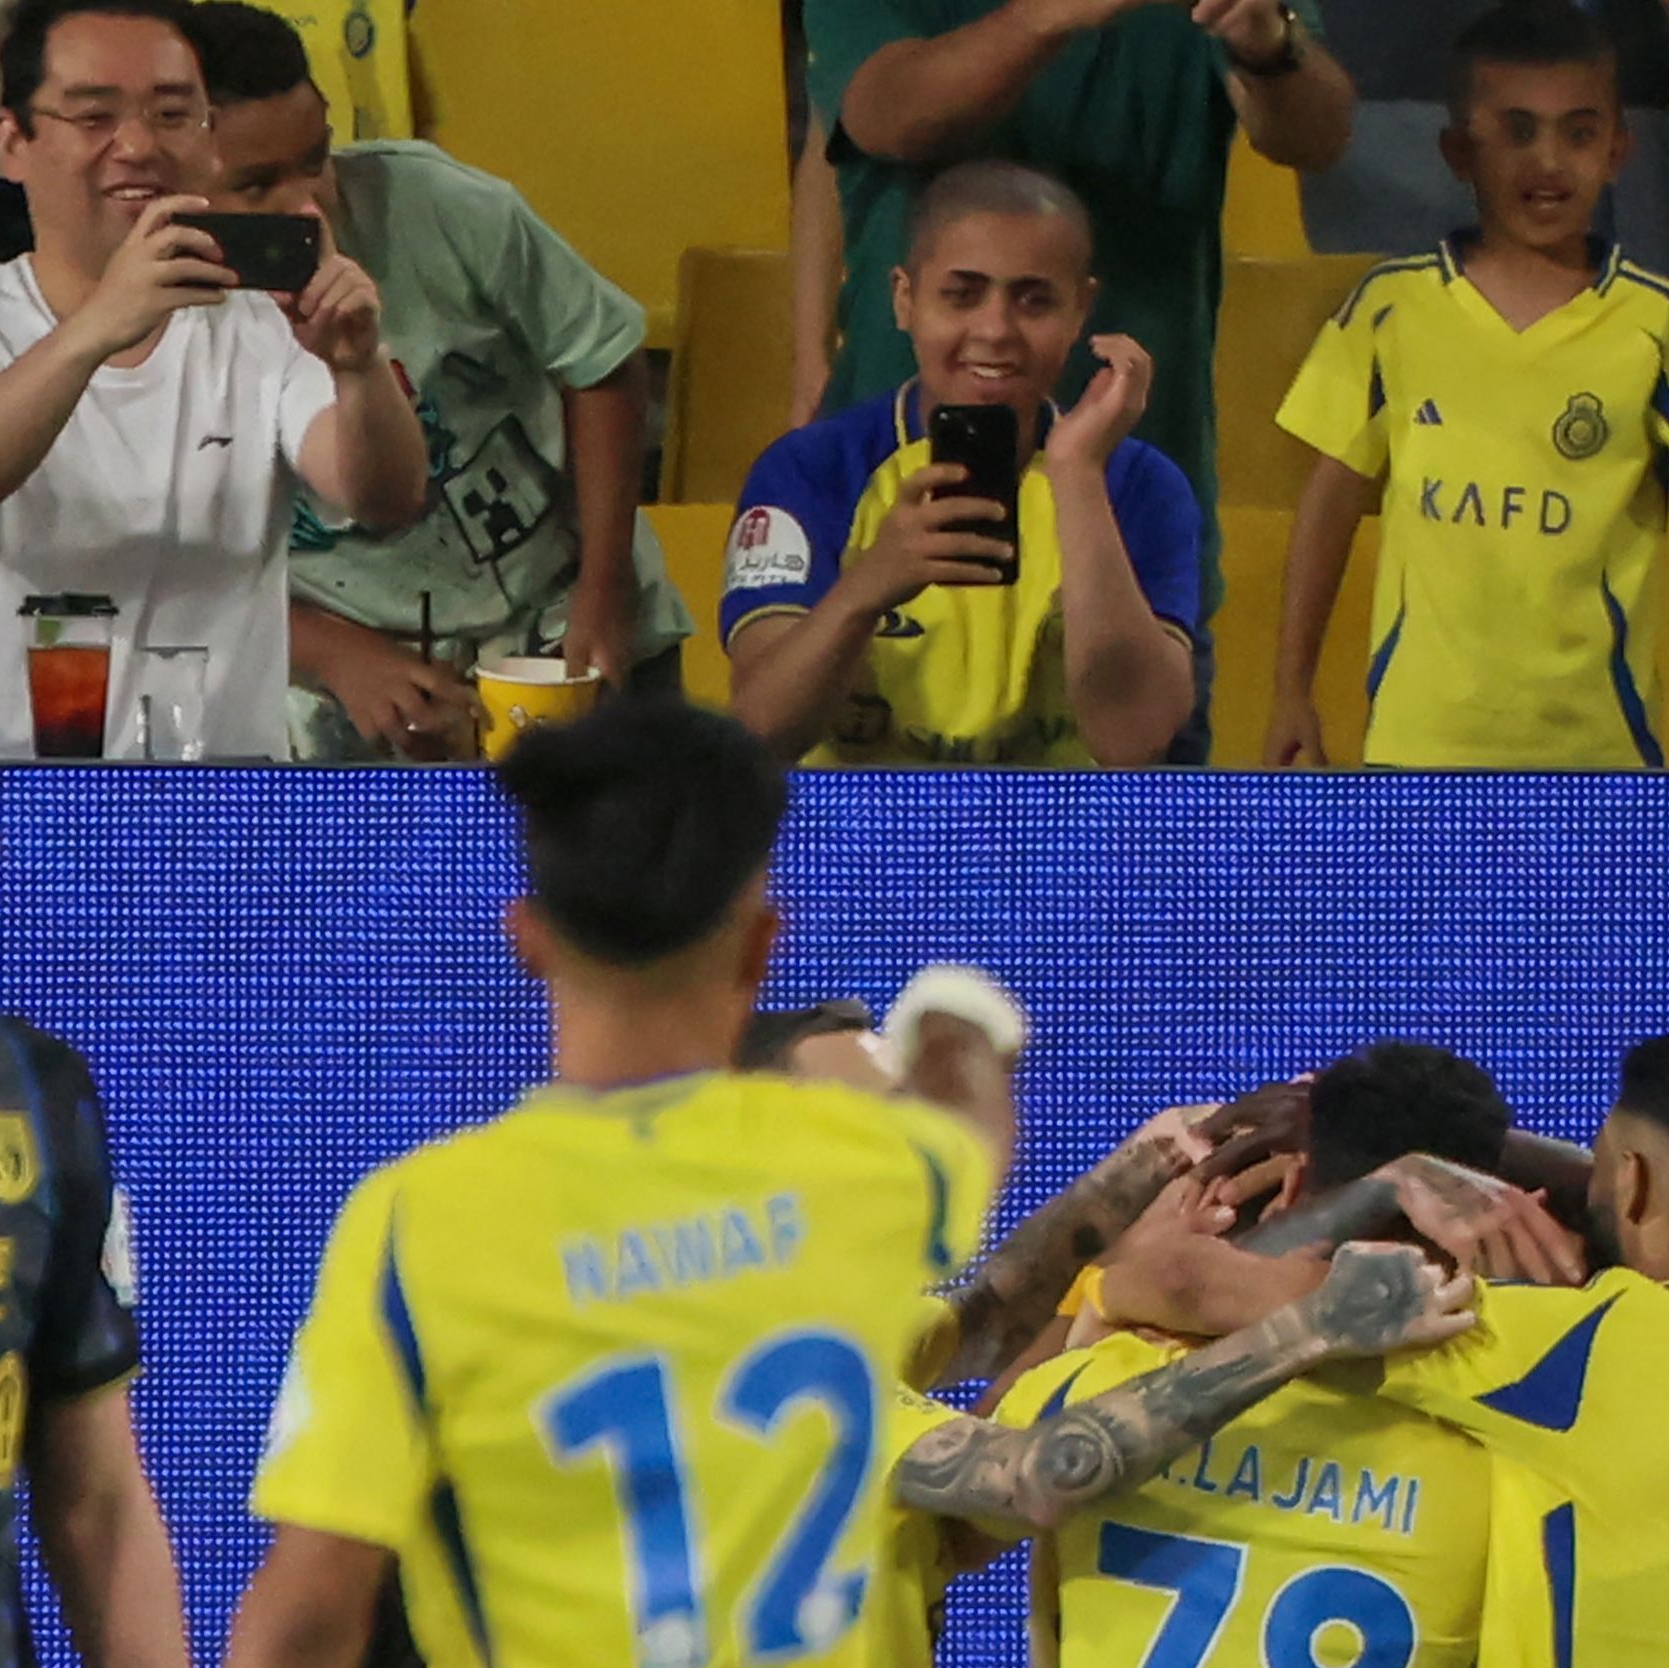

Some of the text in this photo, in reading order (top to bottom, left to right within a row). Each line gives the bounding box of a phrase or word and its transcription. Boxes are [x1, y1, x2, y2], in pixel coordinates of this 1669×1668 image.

[1421, 476, 1573, 535] KAFD
[560, 1190, 806, 1310] NAWAF
[1160, 1428, 1421, 1540] .LAJAMI
